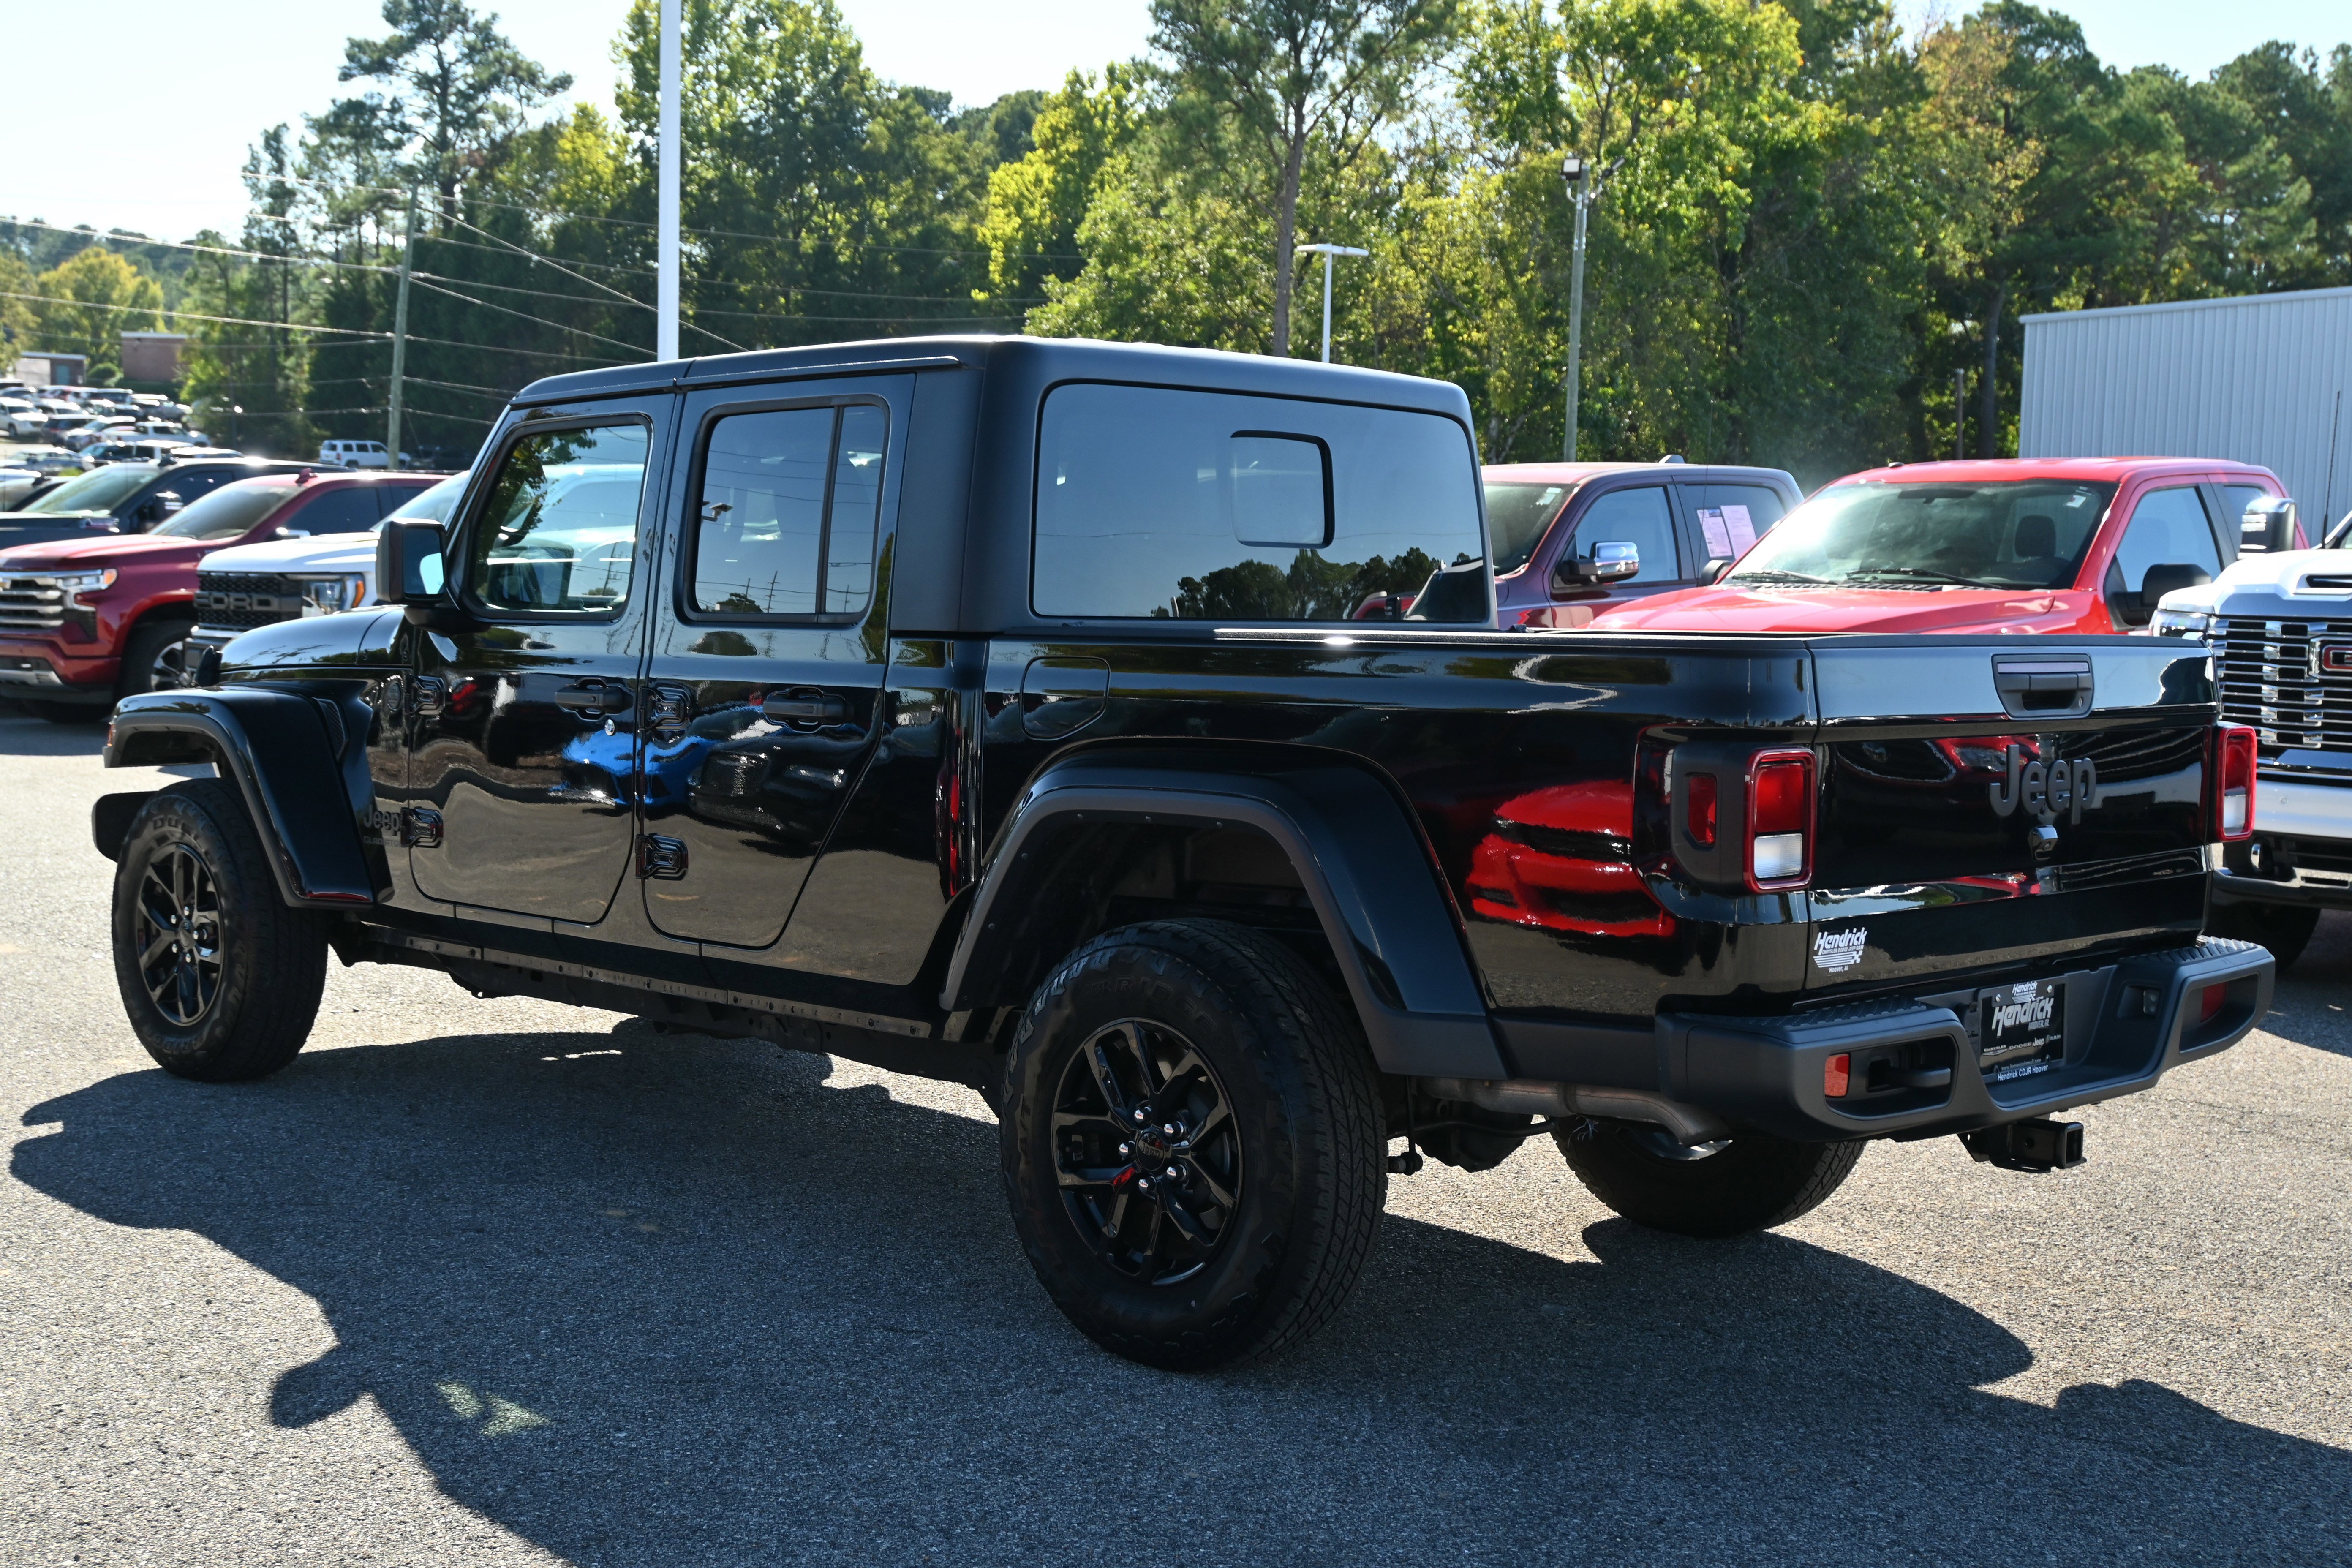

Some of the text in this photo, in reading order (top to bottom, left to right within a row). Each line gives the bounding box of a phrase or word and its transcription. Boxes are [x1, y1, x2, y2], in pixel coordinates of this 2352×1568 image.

[194, 591, 280, 611] FORD
[1989, 743, 2096, 825] Jeep
[363, 804, 400, 836] Jeep
[363, 836, 401, 846] GLADIATO
[1813, 927, 1867, 956] Hendrick
[2012, 981, 2038, 996] Hendrick
[1991, 997, 2054, 1037] Hendrick
[2009, 1042, 2032, 1050] DODGE
[2033, 1037, 2045, 1047] Jeep
[1997, 1064, 2048, 1081] Hendrick CDJR Hoover
